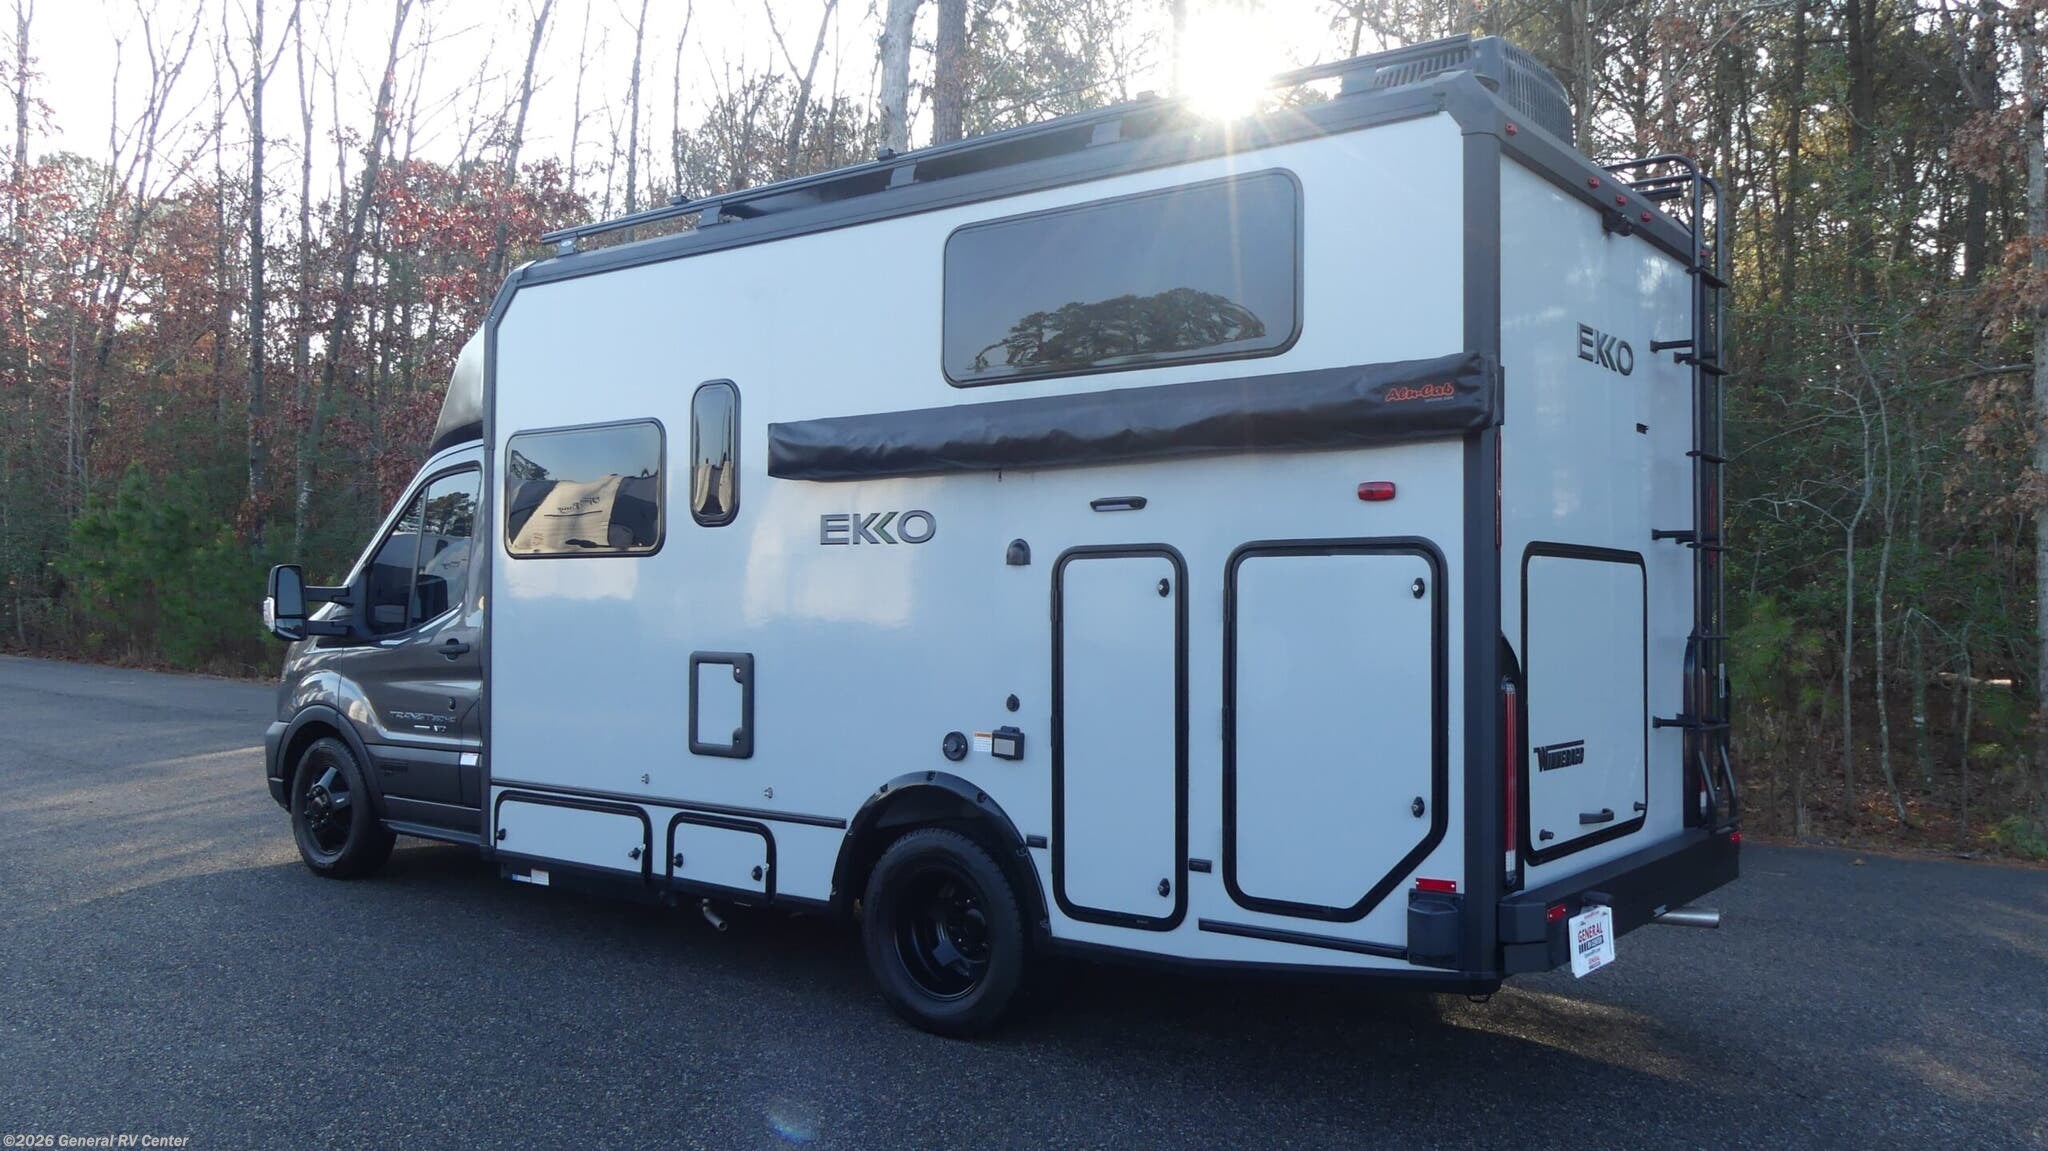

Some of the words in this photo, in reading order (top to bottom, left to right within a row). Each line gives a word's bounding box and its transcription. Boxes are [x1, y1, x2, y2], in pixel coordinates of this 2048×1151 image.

[1577, 321, 1634, 377] EKKO
[1384, 382, 1456, 402] Alu-Cab
[820, 509, 937, 546] EKKO
